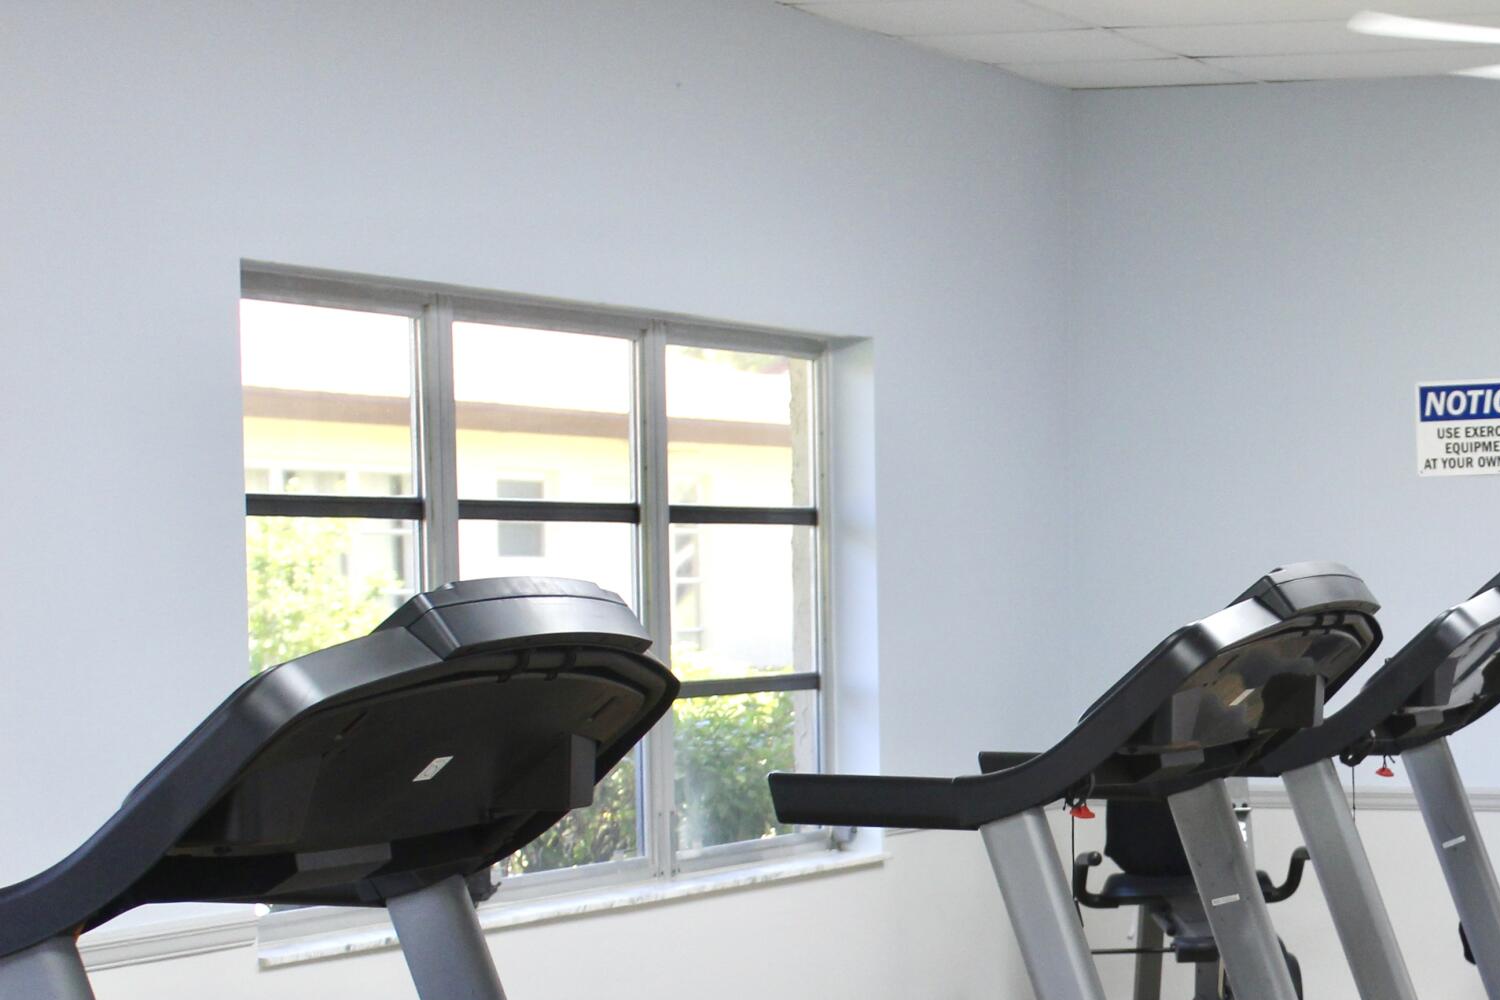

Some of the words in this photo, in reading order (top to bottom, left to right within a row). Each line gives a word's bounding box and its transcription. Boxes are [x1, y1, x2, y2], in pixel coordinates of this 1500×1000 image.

[1437, 427, 1461, 439] USE
[1424, 457, 1438, 470] AT
[1441, 456, 1474, 469] YOUR
